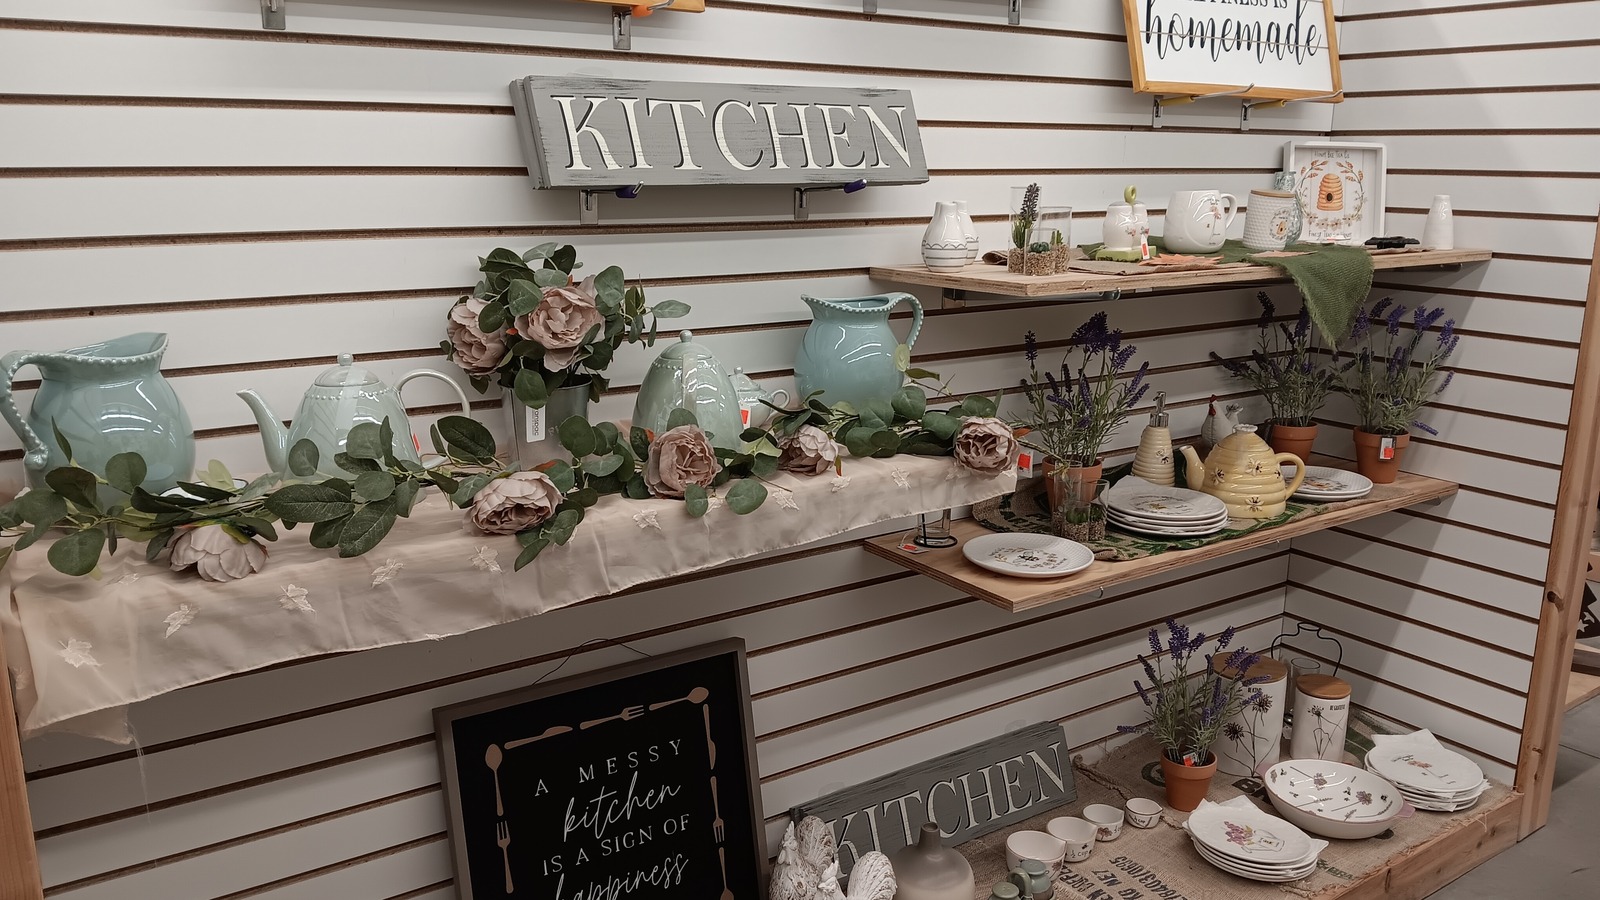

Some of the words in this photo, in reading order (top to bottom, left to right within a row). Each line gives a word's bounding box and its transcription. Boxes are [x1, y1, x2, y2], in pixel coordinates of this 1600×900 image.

[1145, 0, 1322, 65] homemade
[550, 94, 912, 171] KITCHEN
[534, 778, 549, 797] A
[578, 738, 681, 784] MESSY
[563, 770, 681, 842] kitchen
[826, 741, 1065, 879] KITCHEN
[543, 855, 563, 876] IS
[575, 848, 590, 866] A
[600, 825, 653, 856] SIGN
[663, 813, 690, 836] OF
[1091, 870, 1122, 887] NET
